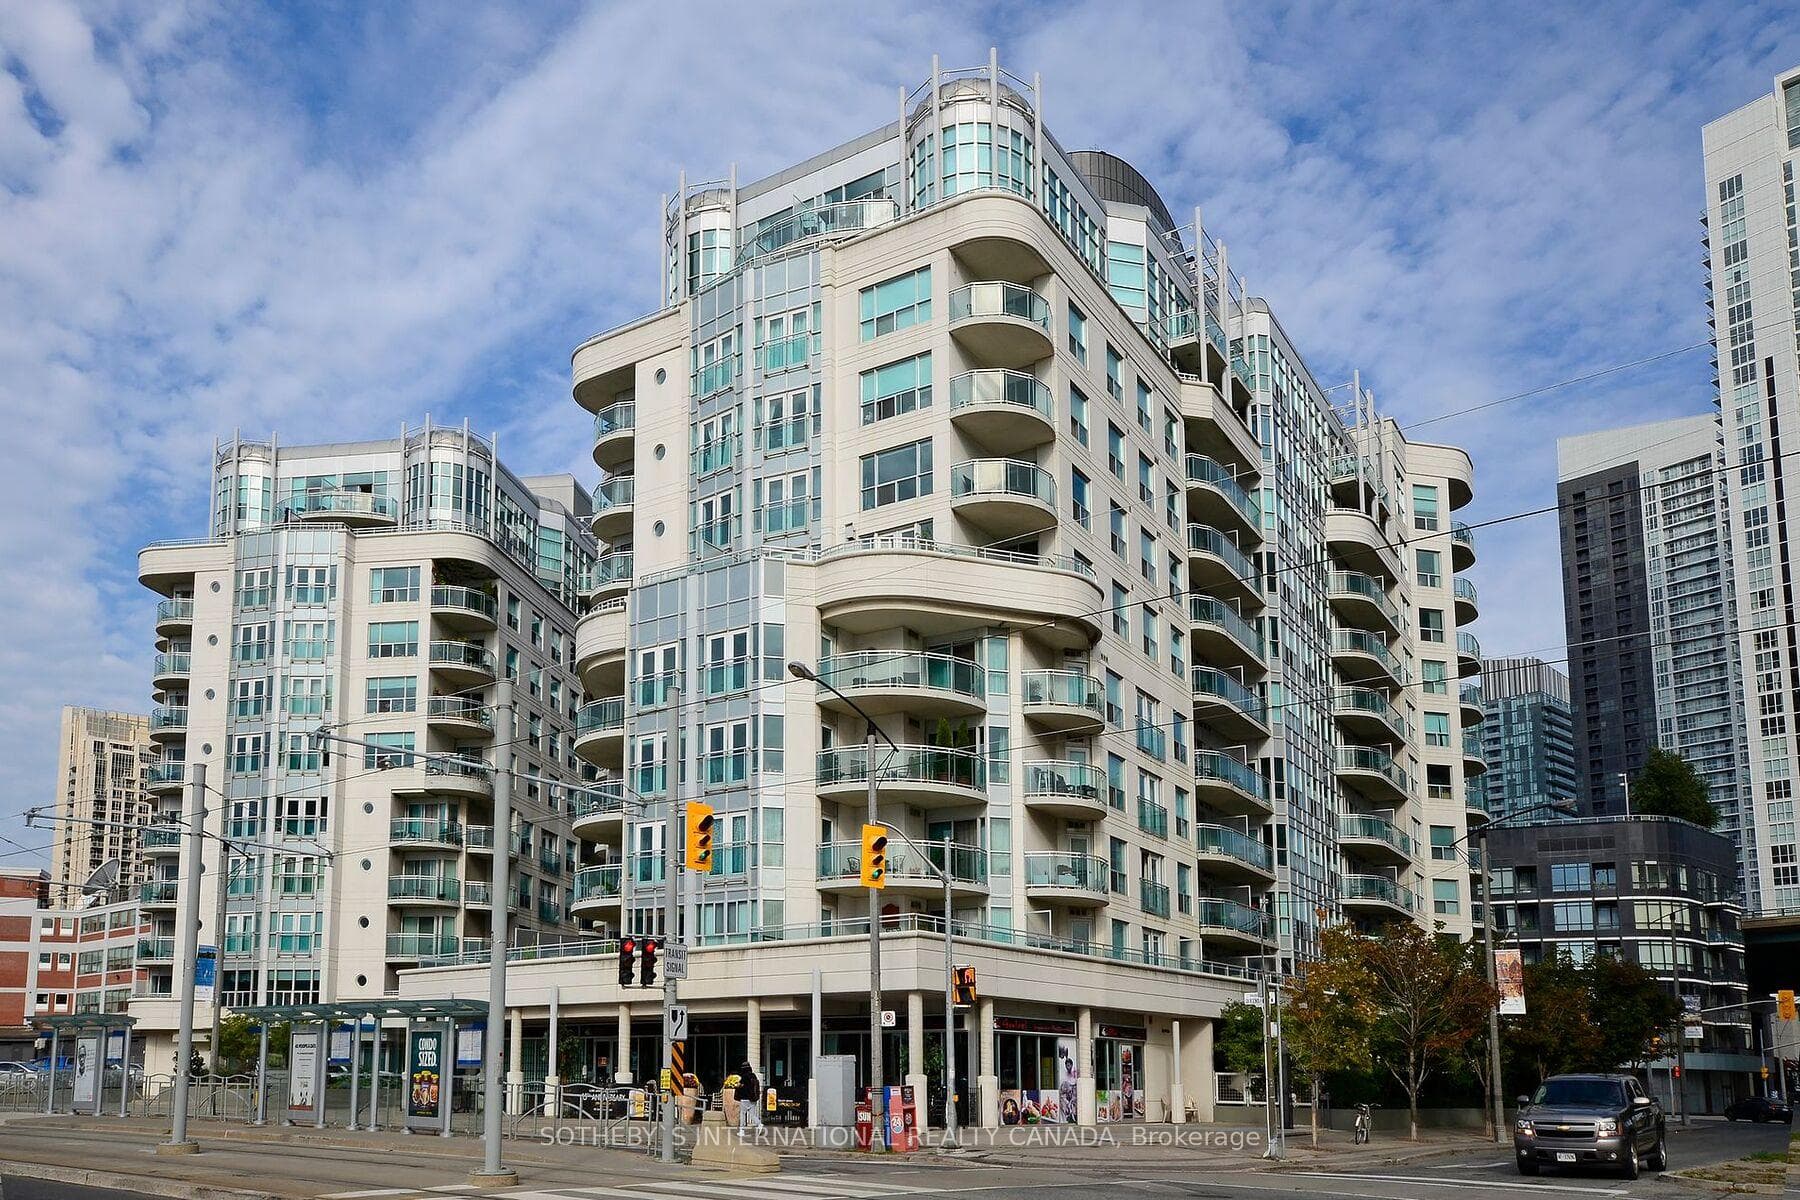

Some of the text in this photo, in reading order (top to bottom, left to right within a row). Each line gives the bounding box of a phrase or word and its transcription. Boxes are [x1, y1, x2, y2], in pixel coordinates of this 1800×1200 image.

[665, 947, 687, 961] TRANSIT
[666, 961, 685, 974] SIGNAL
[418, 1037, 438, 1051] CONDO
[858, 1111, 871, 1122] SUN
